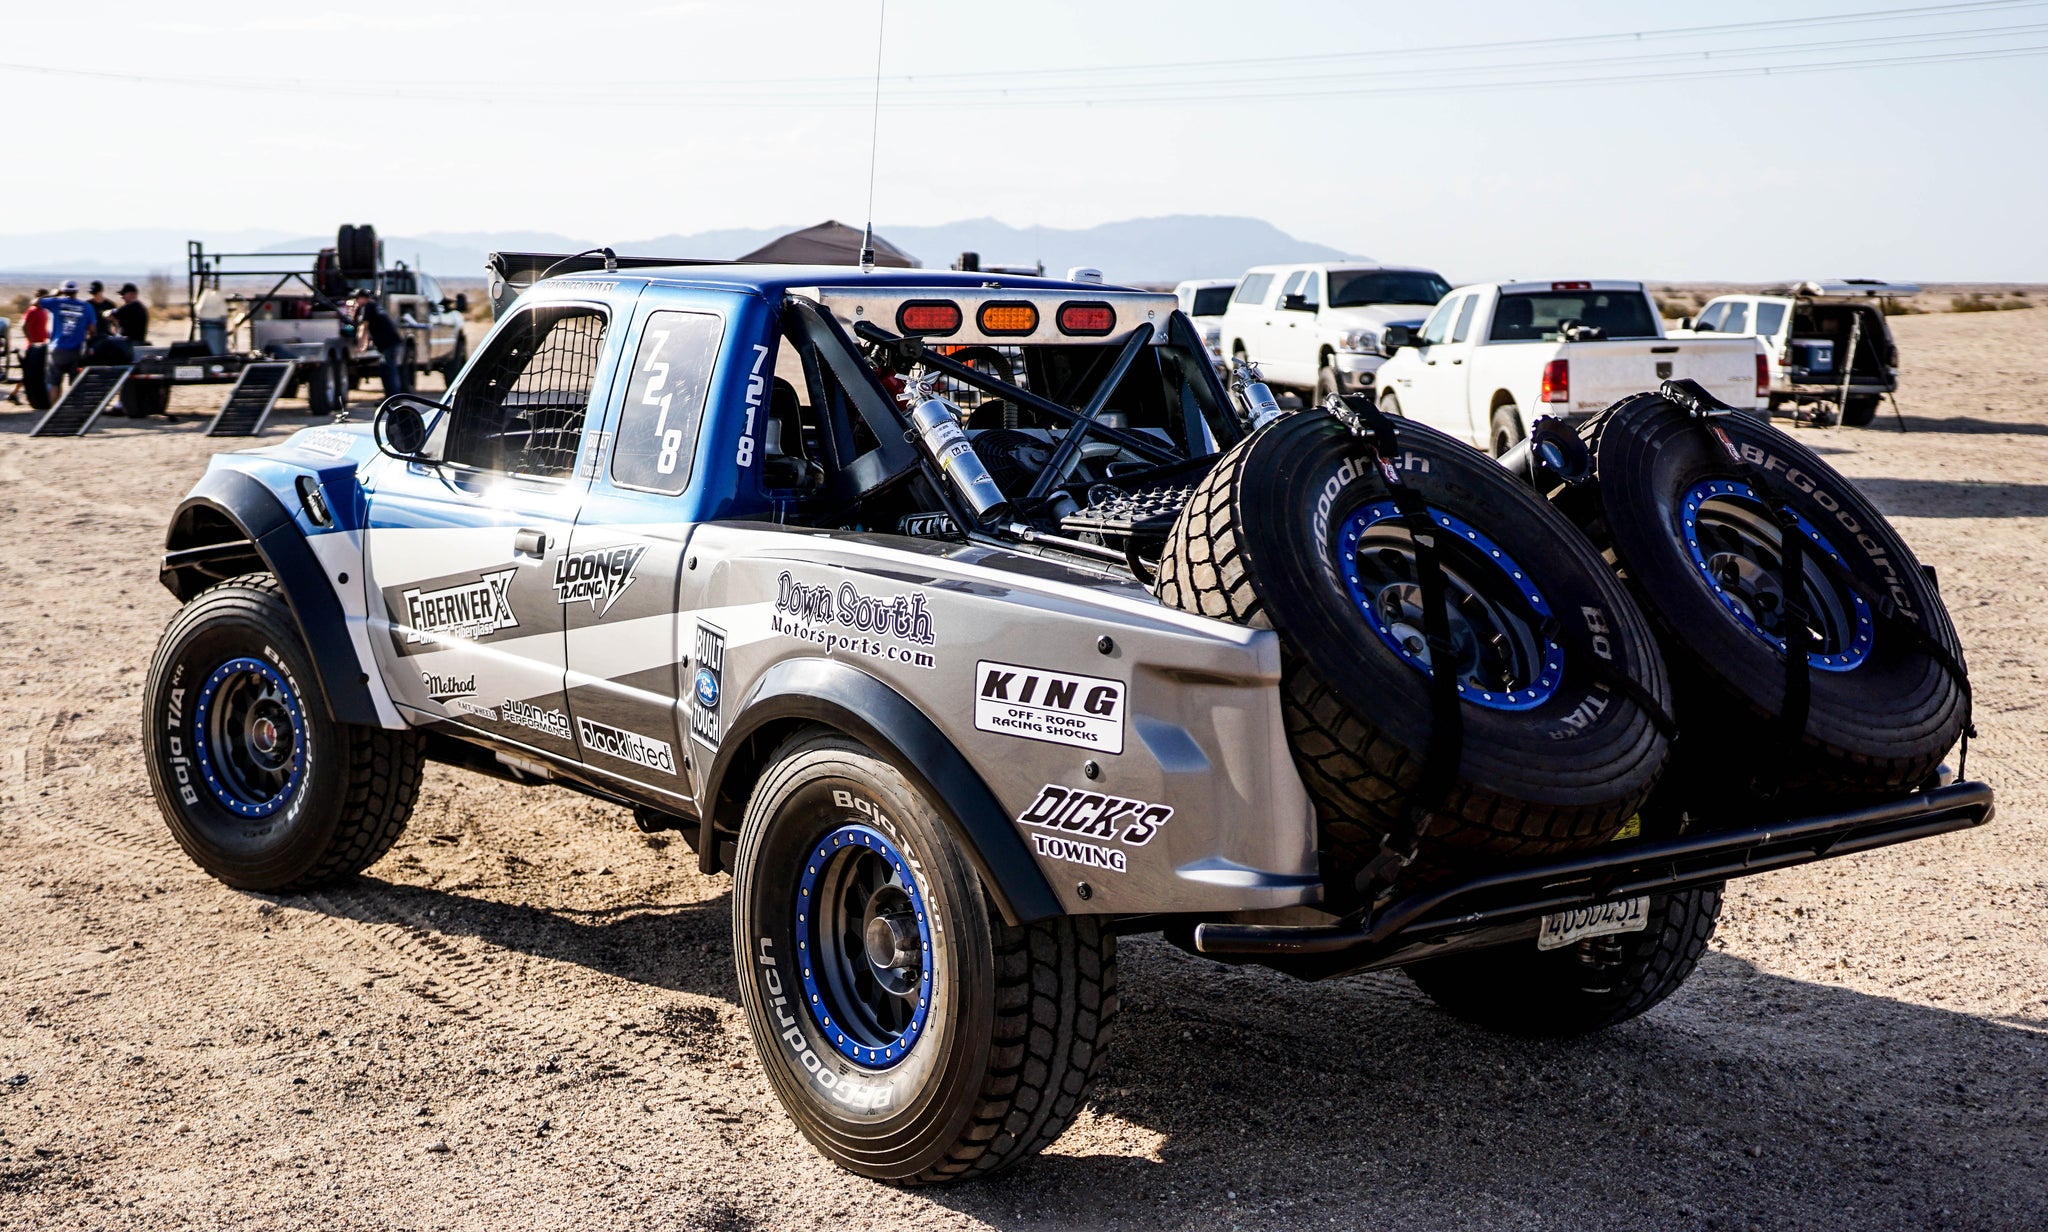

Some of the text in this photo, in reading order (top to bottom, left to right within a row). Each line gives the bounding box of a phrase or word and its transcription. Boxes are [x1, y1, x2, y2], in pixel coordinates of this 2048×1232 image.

[642, 330, 682, 474] 7218
[736, 344, 768, 467] 7218
[555, 547, 645, 590] LOONEY
[560, 581, 602, 600] RACING
[775, 571, 934, 645] Down South
[696, 628, 723, 671] BUILT
[771, 614, 934, 668] Motorsports.com
[421, 671, 477, 694] Method
[700, 676, 714, 698] Ford
[981, 670, 1119, 716] KING
[167, 688, 186, 731] T/A
[503, 711, 571, 738] PERFORMANCE
[693, 702, 719, 741] TOUGH
[992, 717, 1098, 742] RACING SHOCKS
[1008, 709, 1034, 720] OFF
[1046, 715, 1086, 728] ROAD
[580, 719, 673, 772] blacklisted
[168, 736, 199, 806] Baja
[832, 789, 897, 837] Baja
[1021, 786, 1172, 843] DICK'S
[1034, 836, 1124, 870] TOWING
[760, 937, 895, 1110] BFGoodrich
